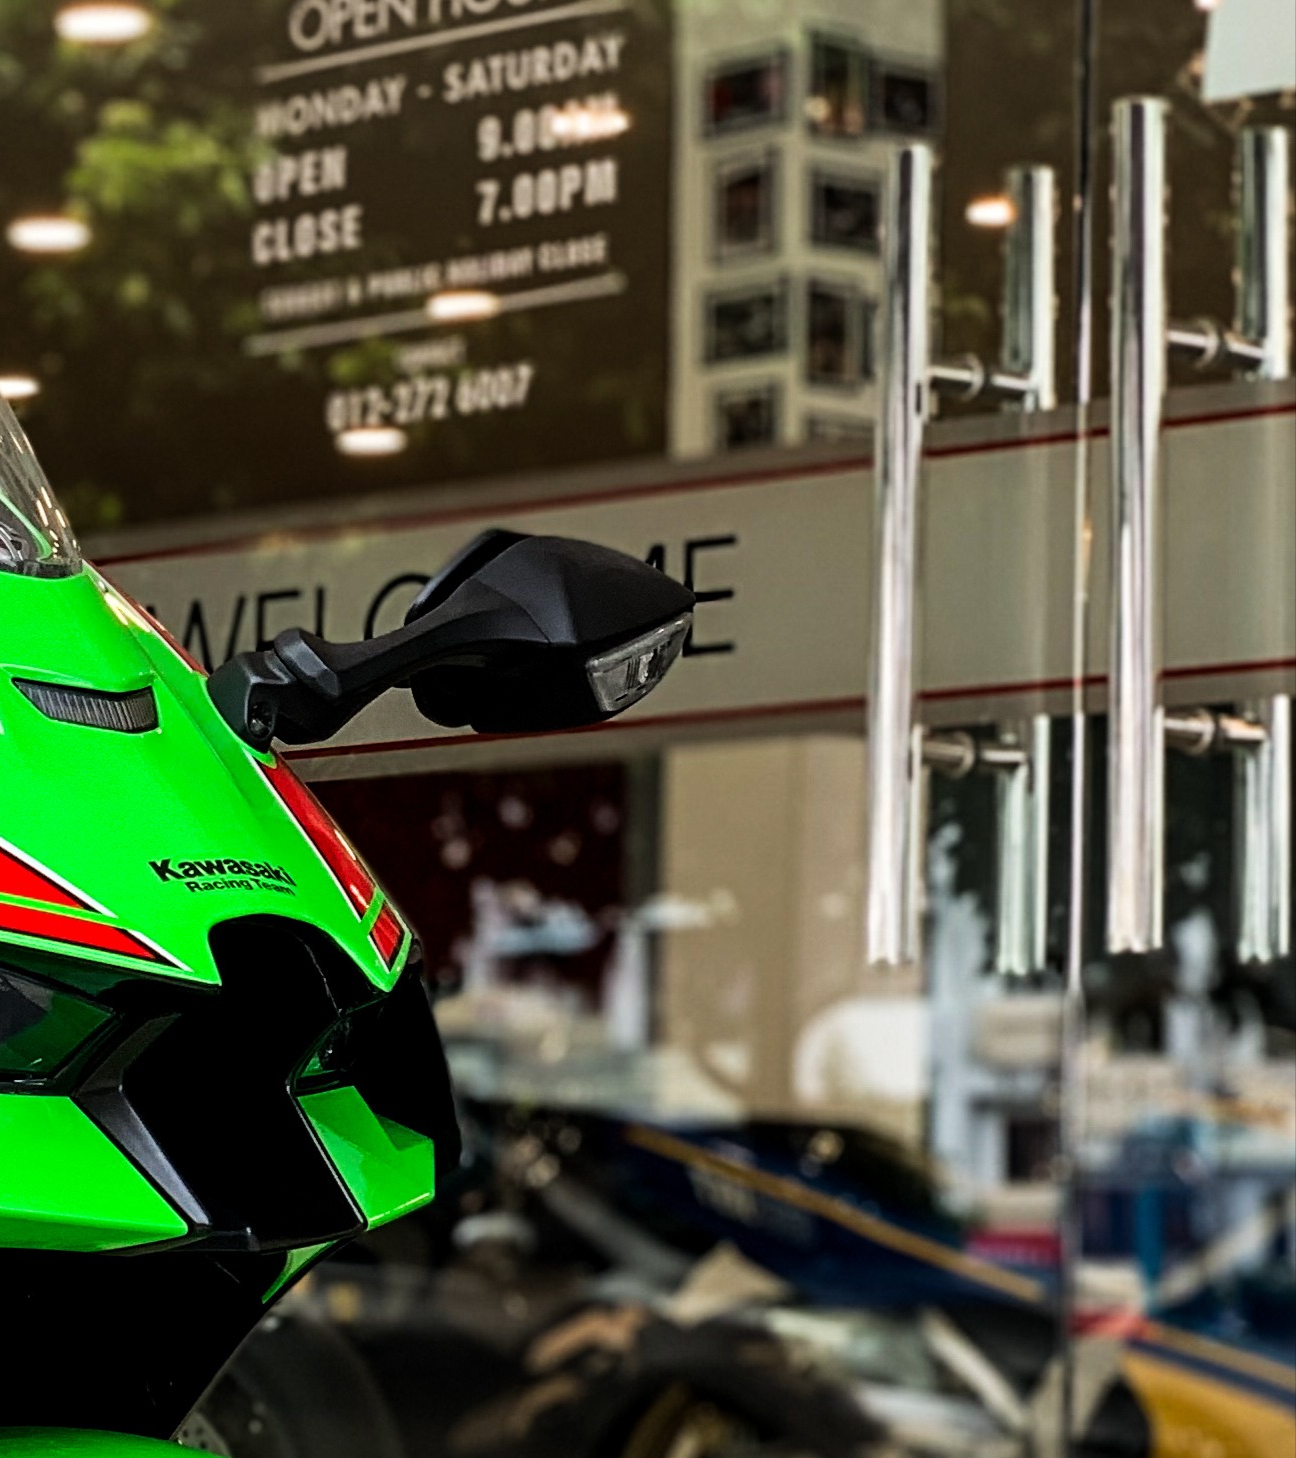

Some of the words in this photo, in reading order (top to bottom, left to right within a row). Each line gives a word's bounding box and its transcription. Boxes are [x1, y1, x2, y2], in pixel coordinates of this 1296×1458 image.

[254, 75, 407, 136] MONDAY
[443, 33, 625, 103] SATURDAY
[252, 146, 347, 203] OPEN
[250, 204, 363, 265] CLOSE
[474, 158, 617, 226] 7.00PM
[148, 858, 298, 887] Kawasaki
[185, 878, 254, 893] Racing
[249, 878, 297, 897] Team
